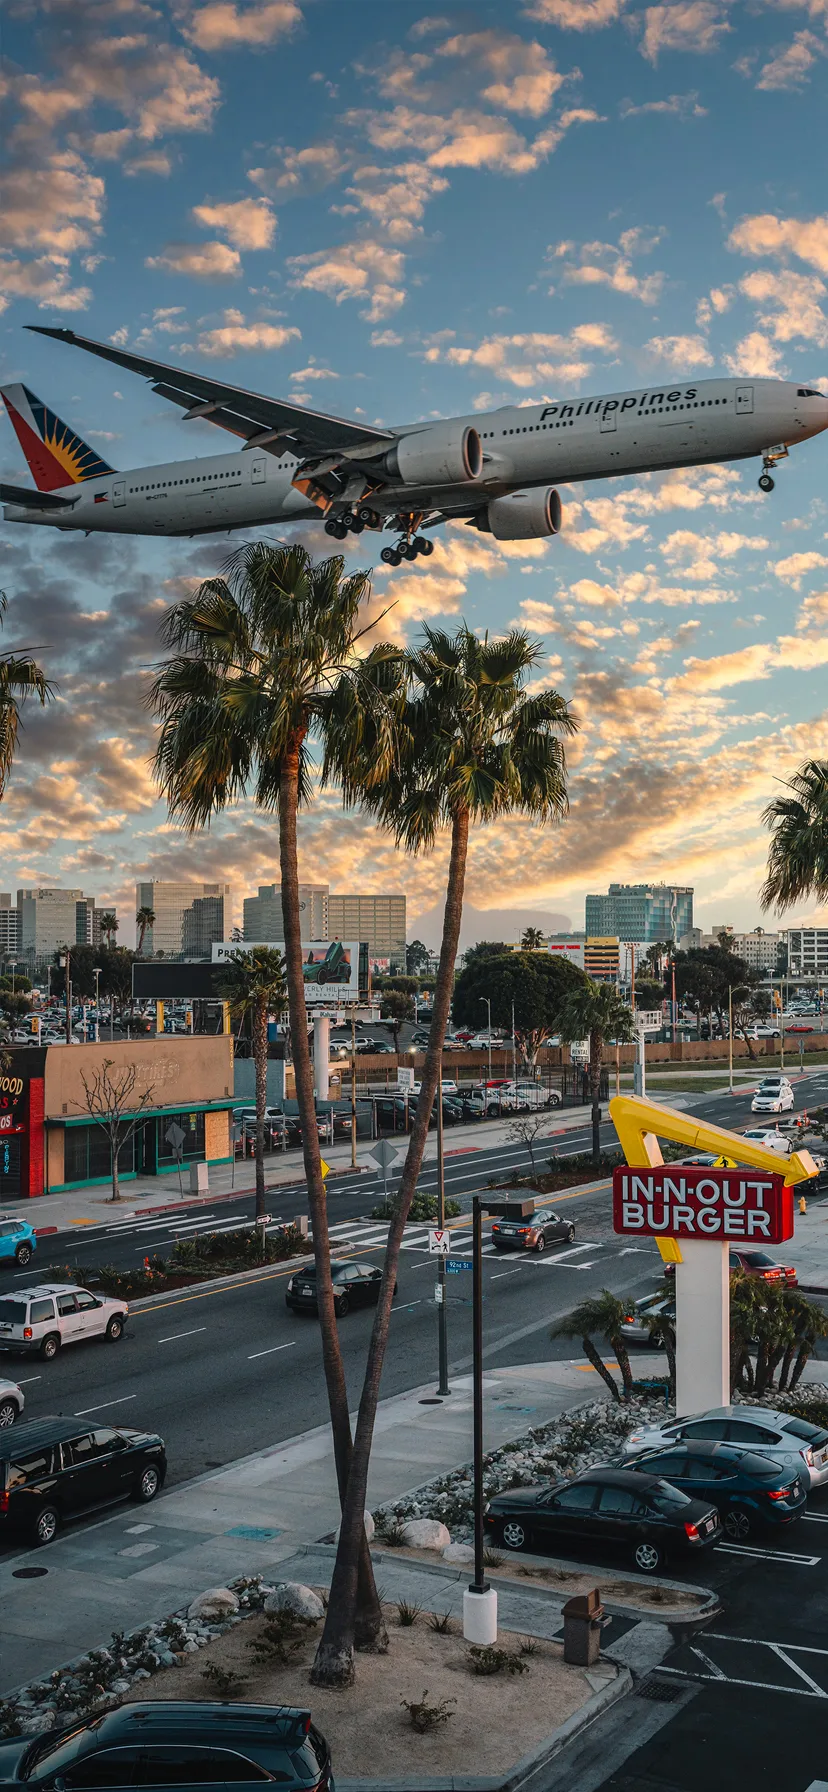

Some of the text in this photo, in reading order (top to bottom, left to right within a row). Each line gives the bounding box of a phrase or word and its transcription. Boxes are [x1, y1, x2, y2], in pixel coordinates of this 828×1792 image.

[539, 388, 698, 421] Philippines
[622, 1175, 773, 1208] IN-N-OUT
[622, 1202, 772, 1237] BURGER
